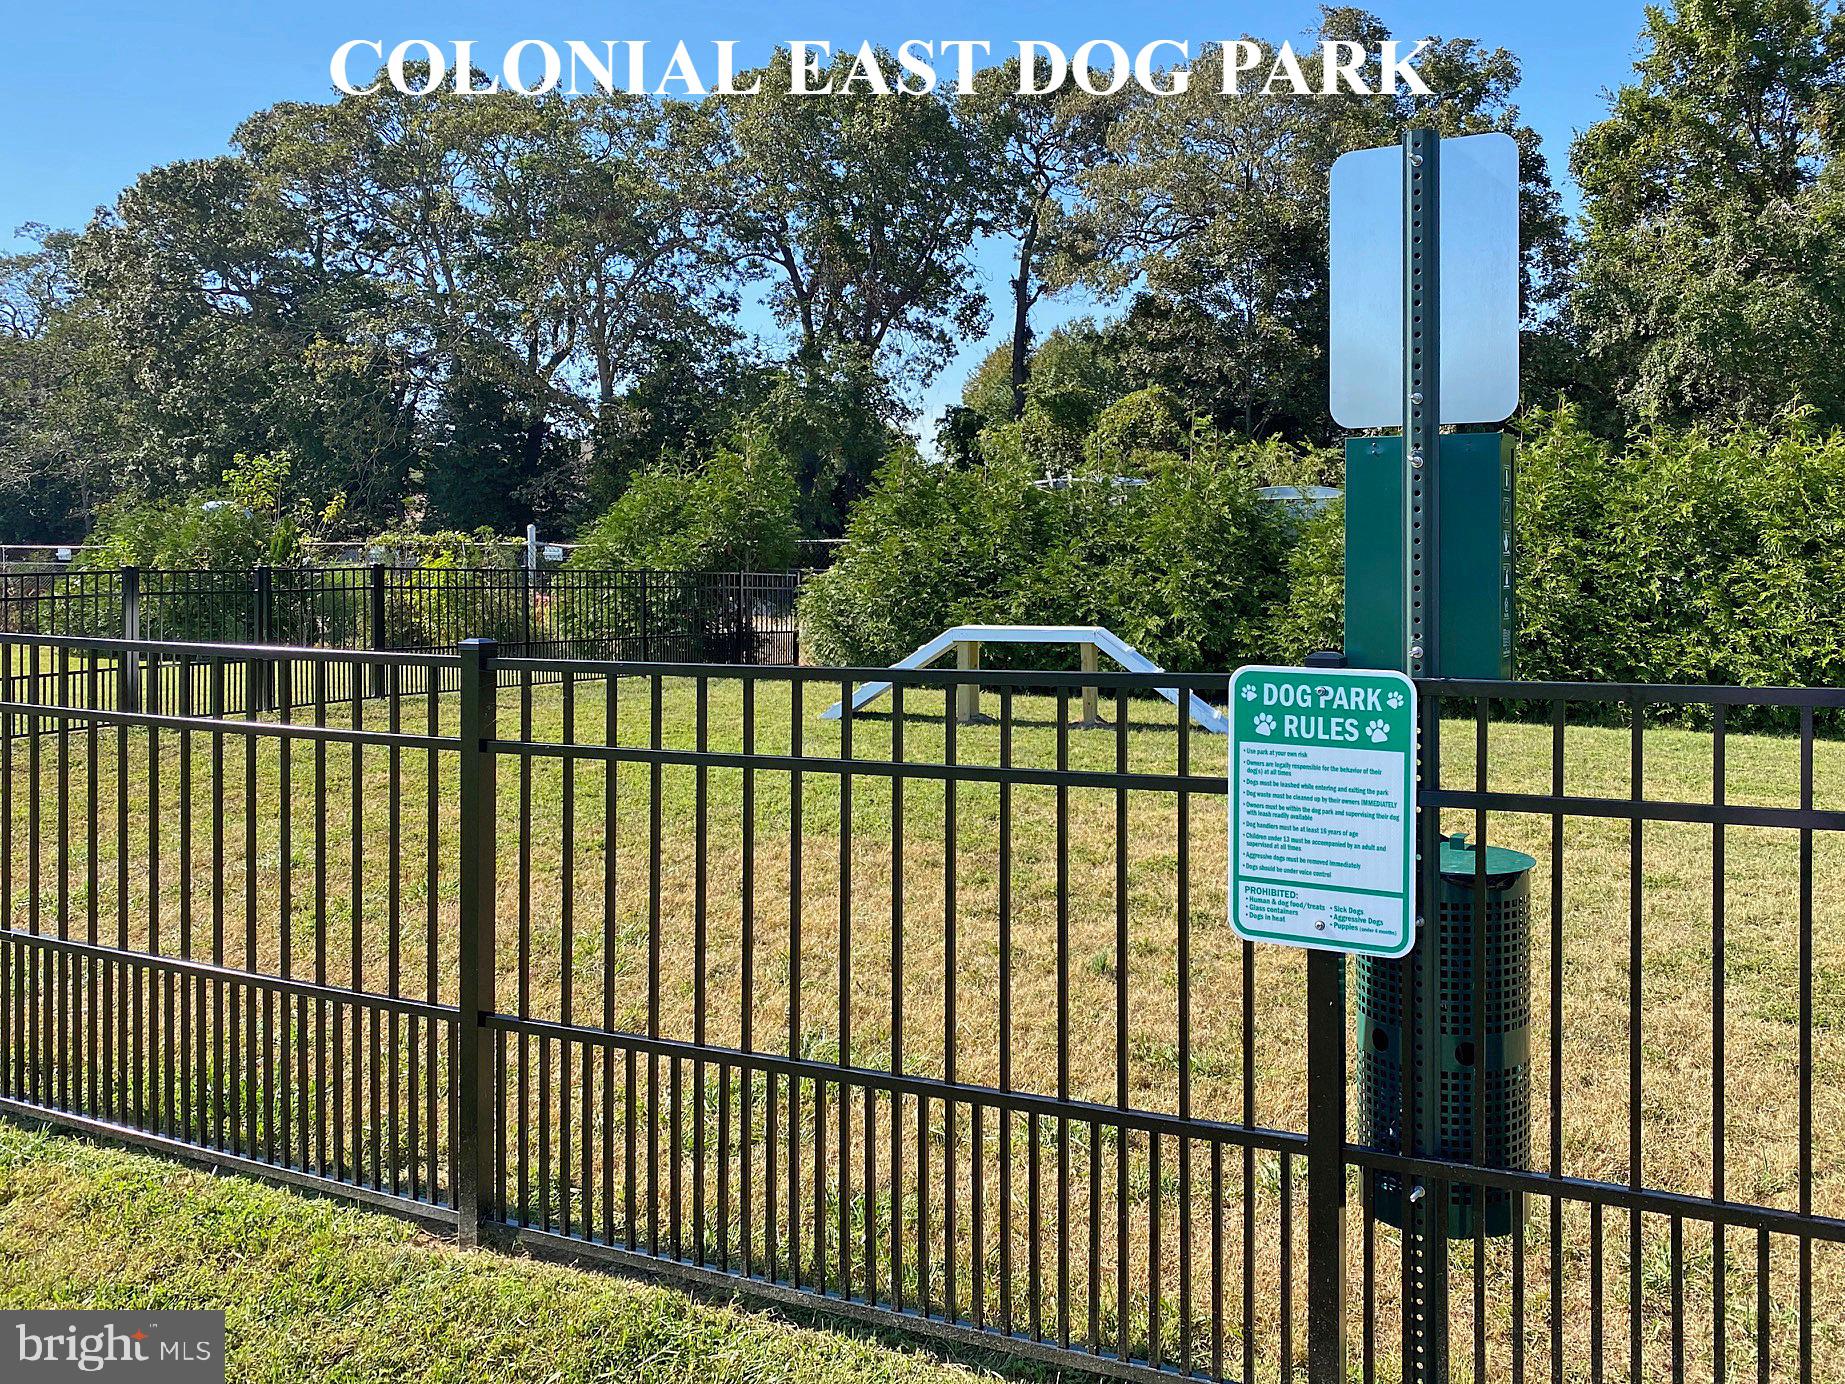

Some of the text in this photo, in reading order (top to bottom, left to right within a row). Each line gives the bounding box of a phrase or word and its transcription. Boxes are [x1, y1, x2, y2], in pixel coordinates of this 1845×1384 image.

[1263, 682, 1382, 712] DOG PARK
[1284, 714, 1359, 742] RULES
[1361, 799, 1397, 808] IMMEDIATELY
[1346, 811, 1375, 819] supervising
[1329, 860, 1361, 870] immediately
[1245, 886, 1298, 899] PROHIBITED:
[1278, 899, 1289, 907] dog
[1290, 900, 1325, 910] food/treats
[1267, 907, 1298, 915] containers
[1349, 907, 1364, 915] Dogs
[1334, 914, 1383, 926] Aggressive Dogs
[1334, 922, 1358, 931] Puppies
